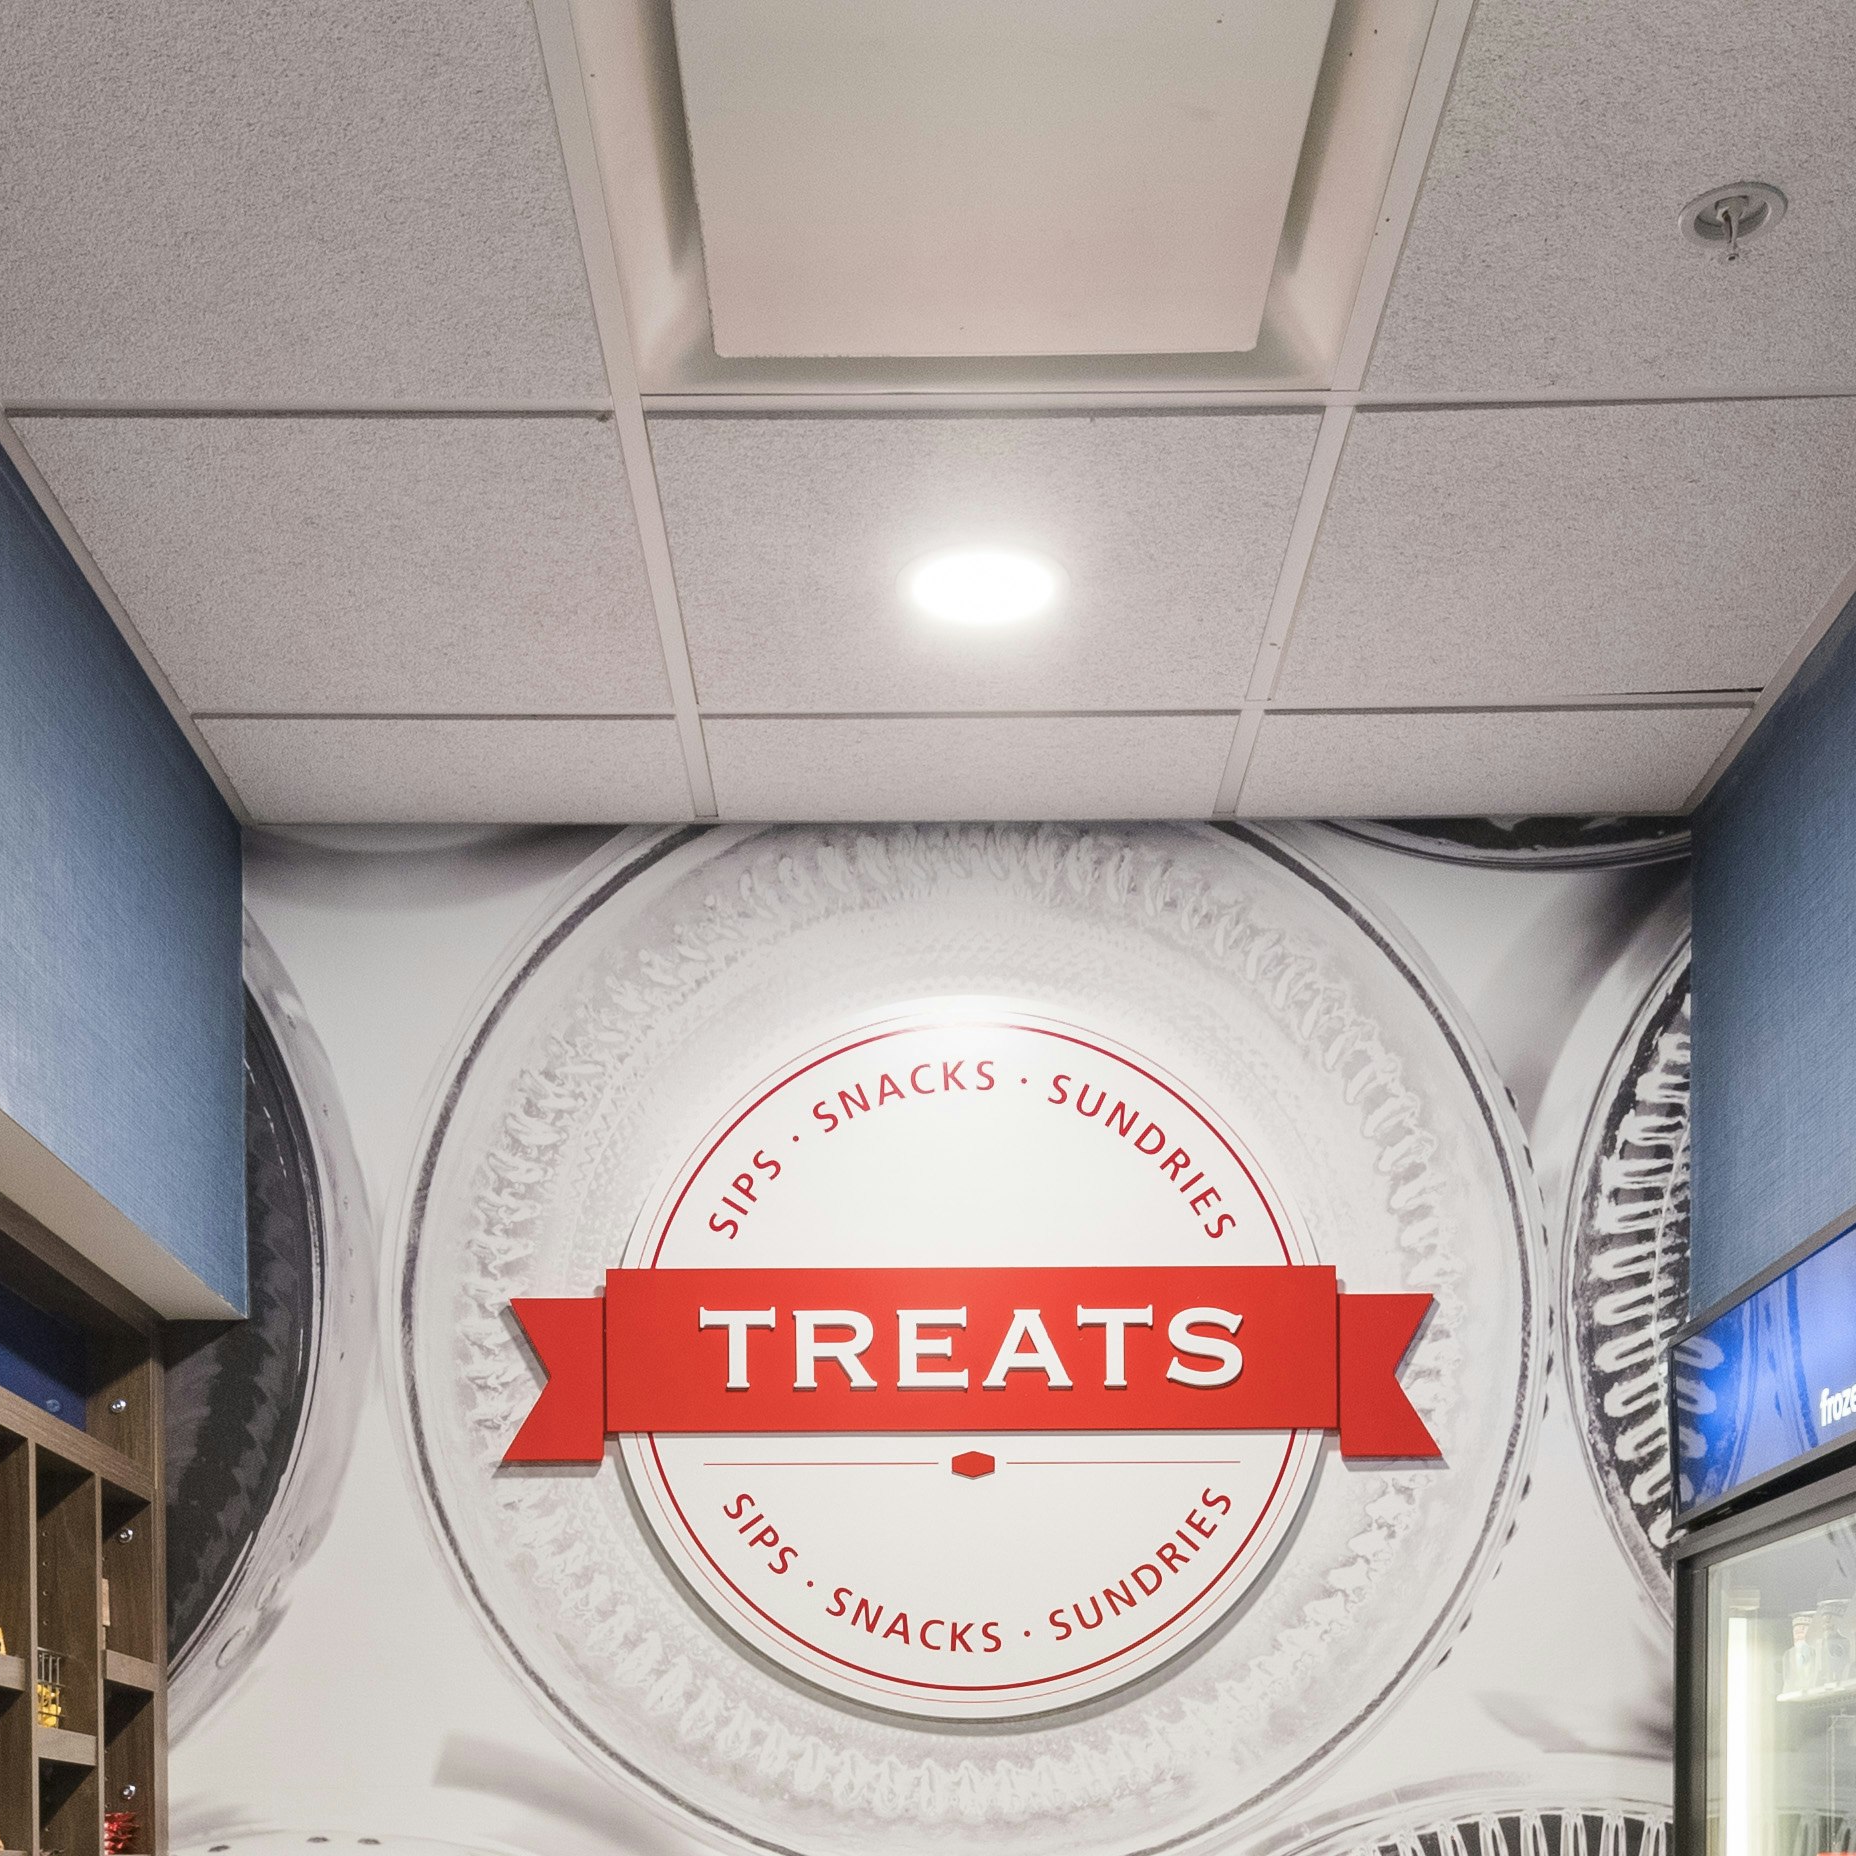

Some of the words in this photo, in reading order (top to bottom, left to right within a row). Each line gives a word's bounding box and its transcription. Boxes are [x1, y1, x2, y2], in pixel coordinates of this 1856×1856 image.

[707, 1148, 783, 1241] SIPS
[811, 1059, 996, 1134] SNACKS
[1047, 1073, 1237, 1241] SUNDRIES
[699, 1305, 1245, 1391] TREATS
[722, 1492, 798, 1577] SIPS
[826, 1584, 1002, 1655] SNACKS
[1050, 1487, 1233, 1641] SUNDRIES
